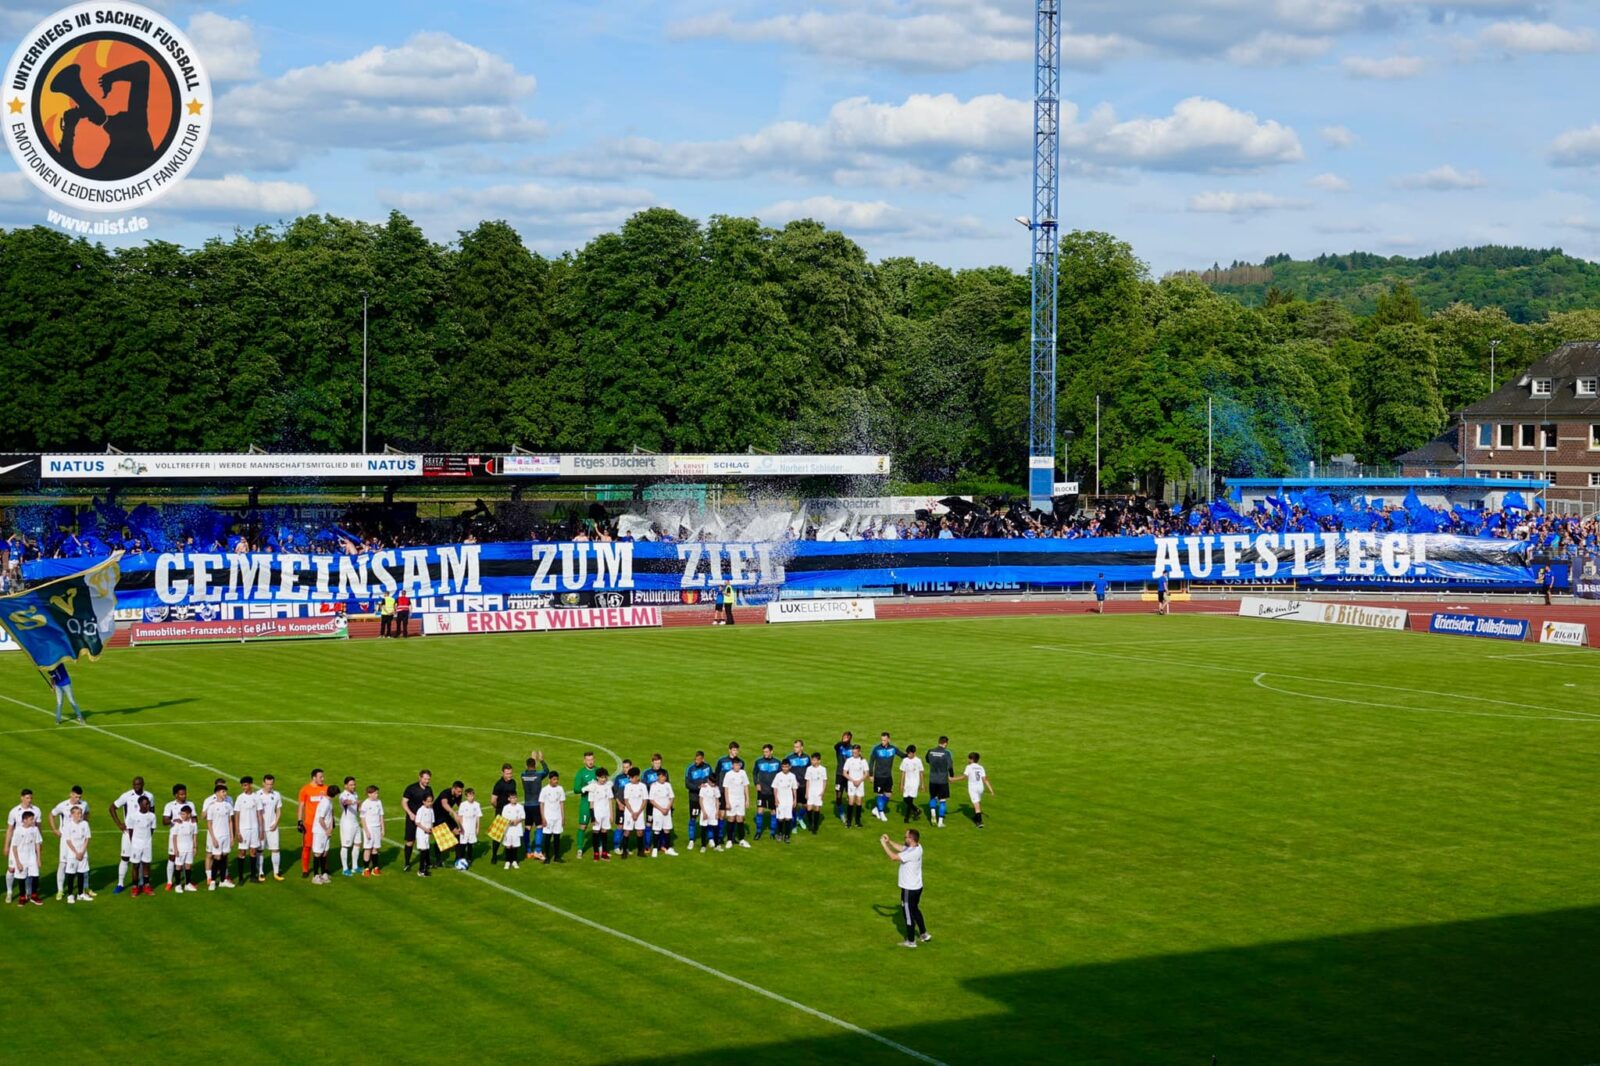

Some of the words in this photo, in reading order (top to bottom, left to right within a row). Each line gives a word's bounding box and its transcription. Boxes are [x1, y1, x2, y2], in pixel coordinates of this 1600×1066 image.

[50, 460, 105, 472] NATUS
[367, 460, 417, 471] NATUS
[713, 461, 750, 469] SCHLAG
[154, 545, 482, 604] GEMEINSAM
[530, 542, 635, 591] ZUM
[676, 543, 786, 588] ZIEL
[1152, 533, 1427, 579] AUFSTIEG!
[408, 594, 504, 614] ULTRA
[780, 601, 848, 613] LUXELEKTRO
[466, 611, 539, 632] ERNST
[546, 607, 658, 629] WILHELMI
[1336, 606, 1400, 628] Bitburger
[1434, 613, 1475, 632] Trierischer
[1477, 617, 1523, 637] Volksfreund
[136, 625, 237, 637] Immobilien-Franzen.de
[289, 622, 335, 633] Kompetenz
